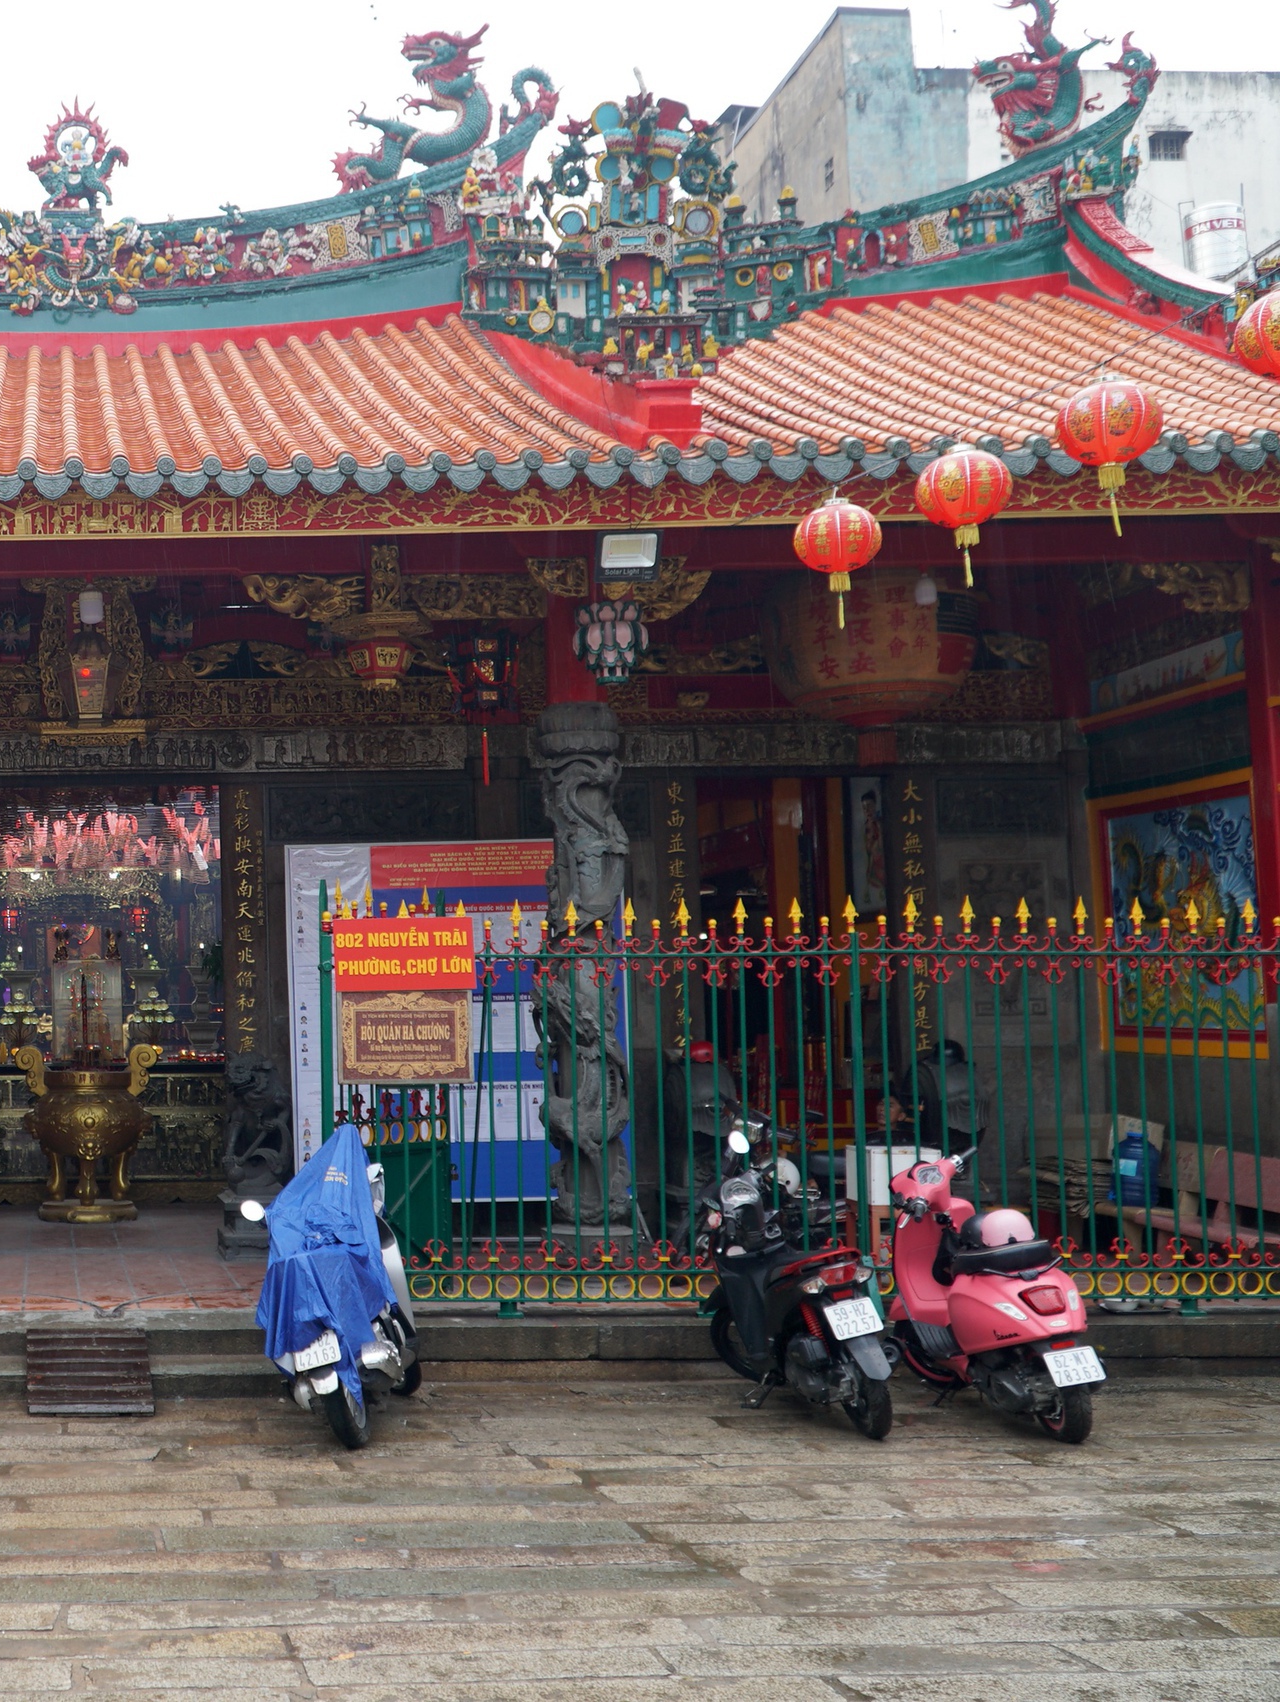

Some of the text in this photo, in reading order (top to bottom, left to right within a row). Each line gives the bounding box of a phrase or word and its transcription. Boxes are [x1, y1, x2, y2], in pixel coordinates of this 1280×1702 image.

[884, 586, 908, 659] 理事會
[479, 903, 494, 912] QUỐC
[495, 902, 506, 911] HỘI
[336, 926, 468, 948] 802 NGUYỄN TRÃI
[441, 955, 473, 973] LỚN
[361, 1021, 376, 1044] HỘI
[377, 1021, 401, 1044] QUÁN
[402, 1021, 415, 1040] HÀ
[833, 1303, 868, 1321] 59-H2
[836, 1315, 876, 1337] 022.57
[1055, 1364, 1100, 1385] 783.63
